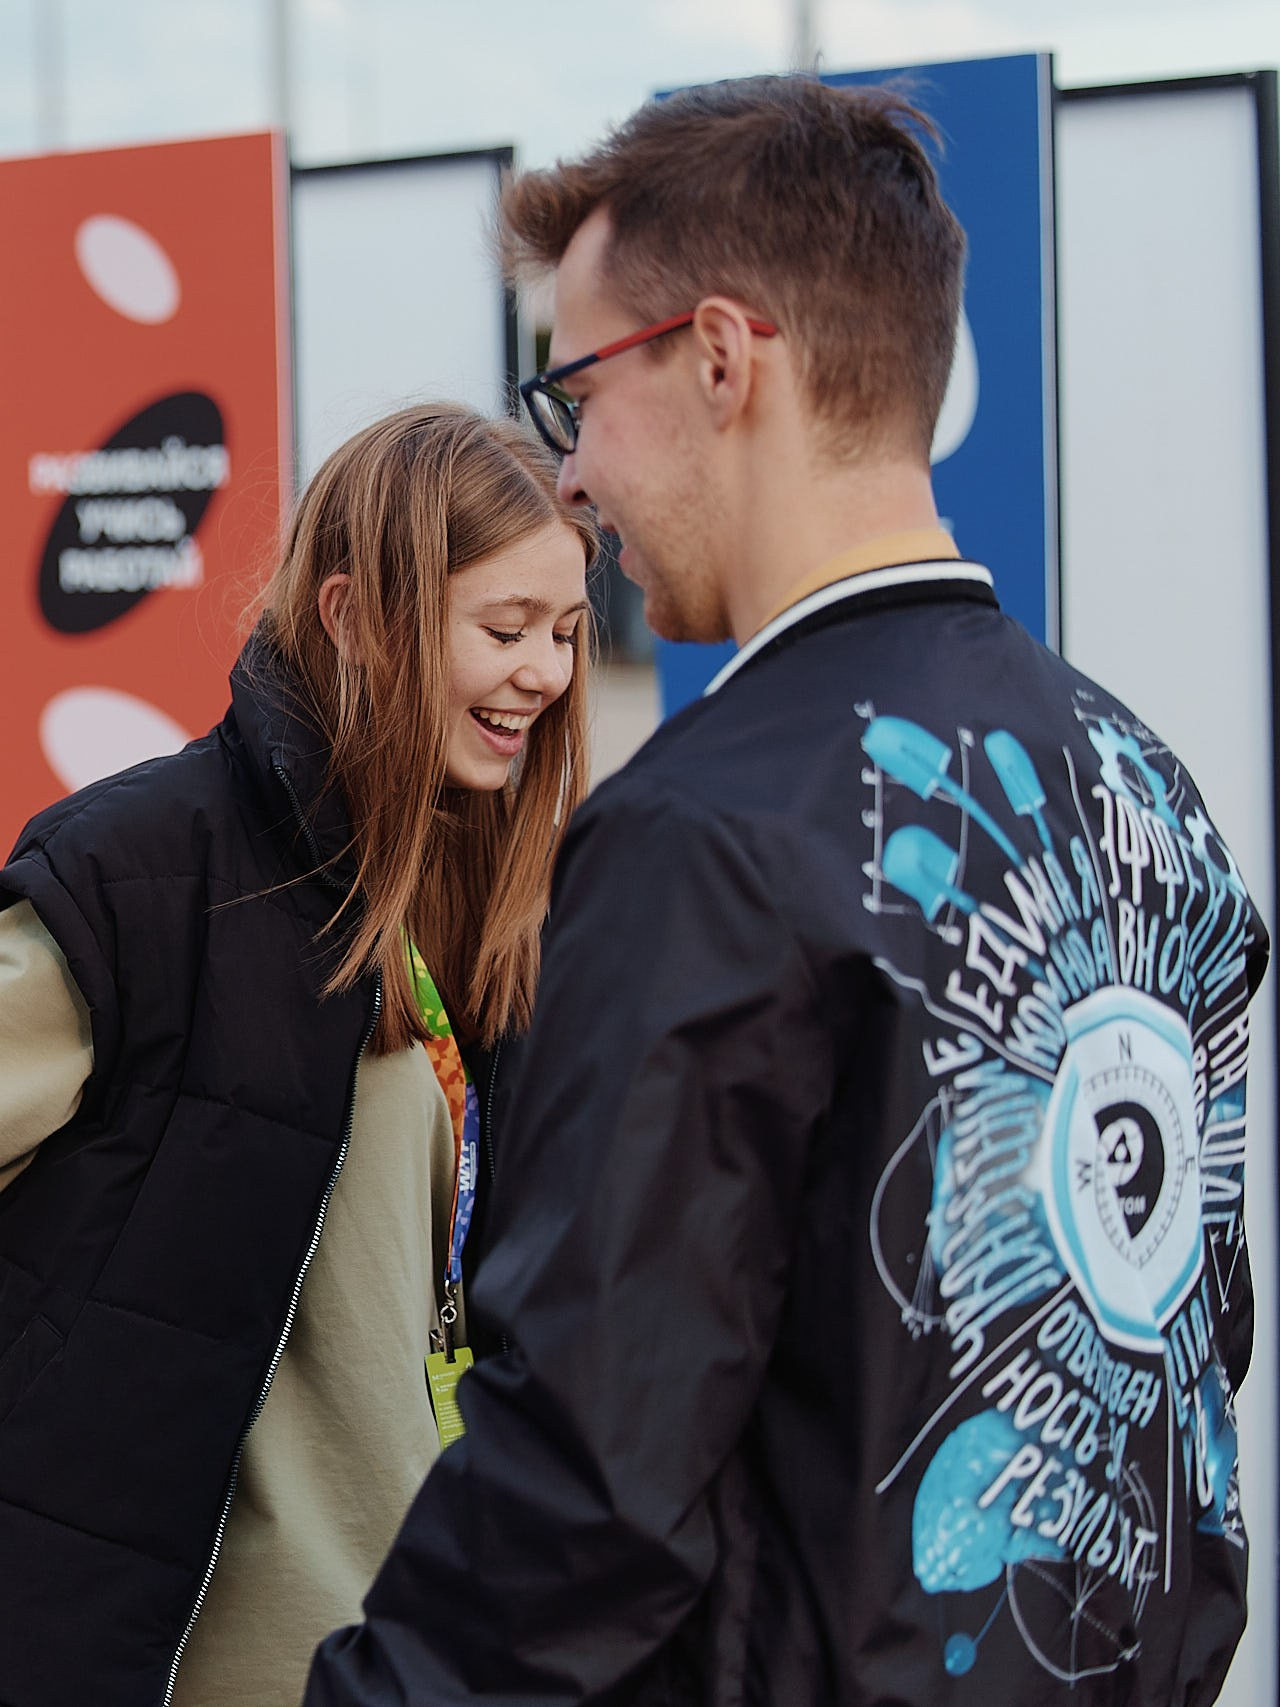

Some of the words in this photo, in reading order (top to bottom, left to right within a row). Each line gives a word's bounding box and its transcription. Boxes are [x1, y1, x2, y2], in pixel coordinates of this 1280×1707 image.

[945, 835, 1101, 1034] ЕДИНАЯ
[1118, 1030, 1132, 1062] N
[982, 1348, 1103, 1465] НОСТЬ
